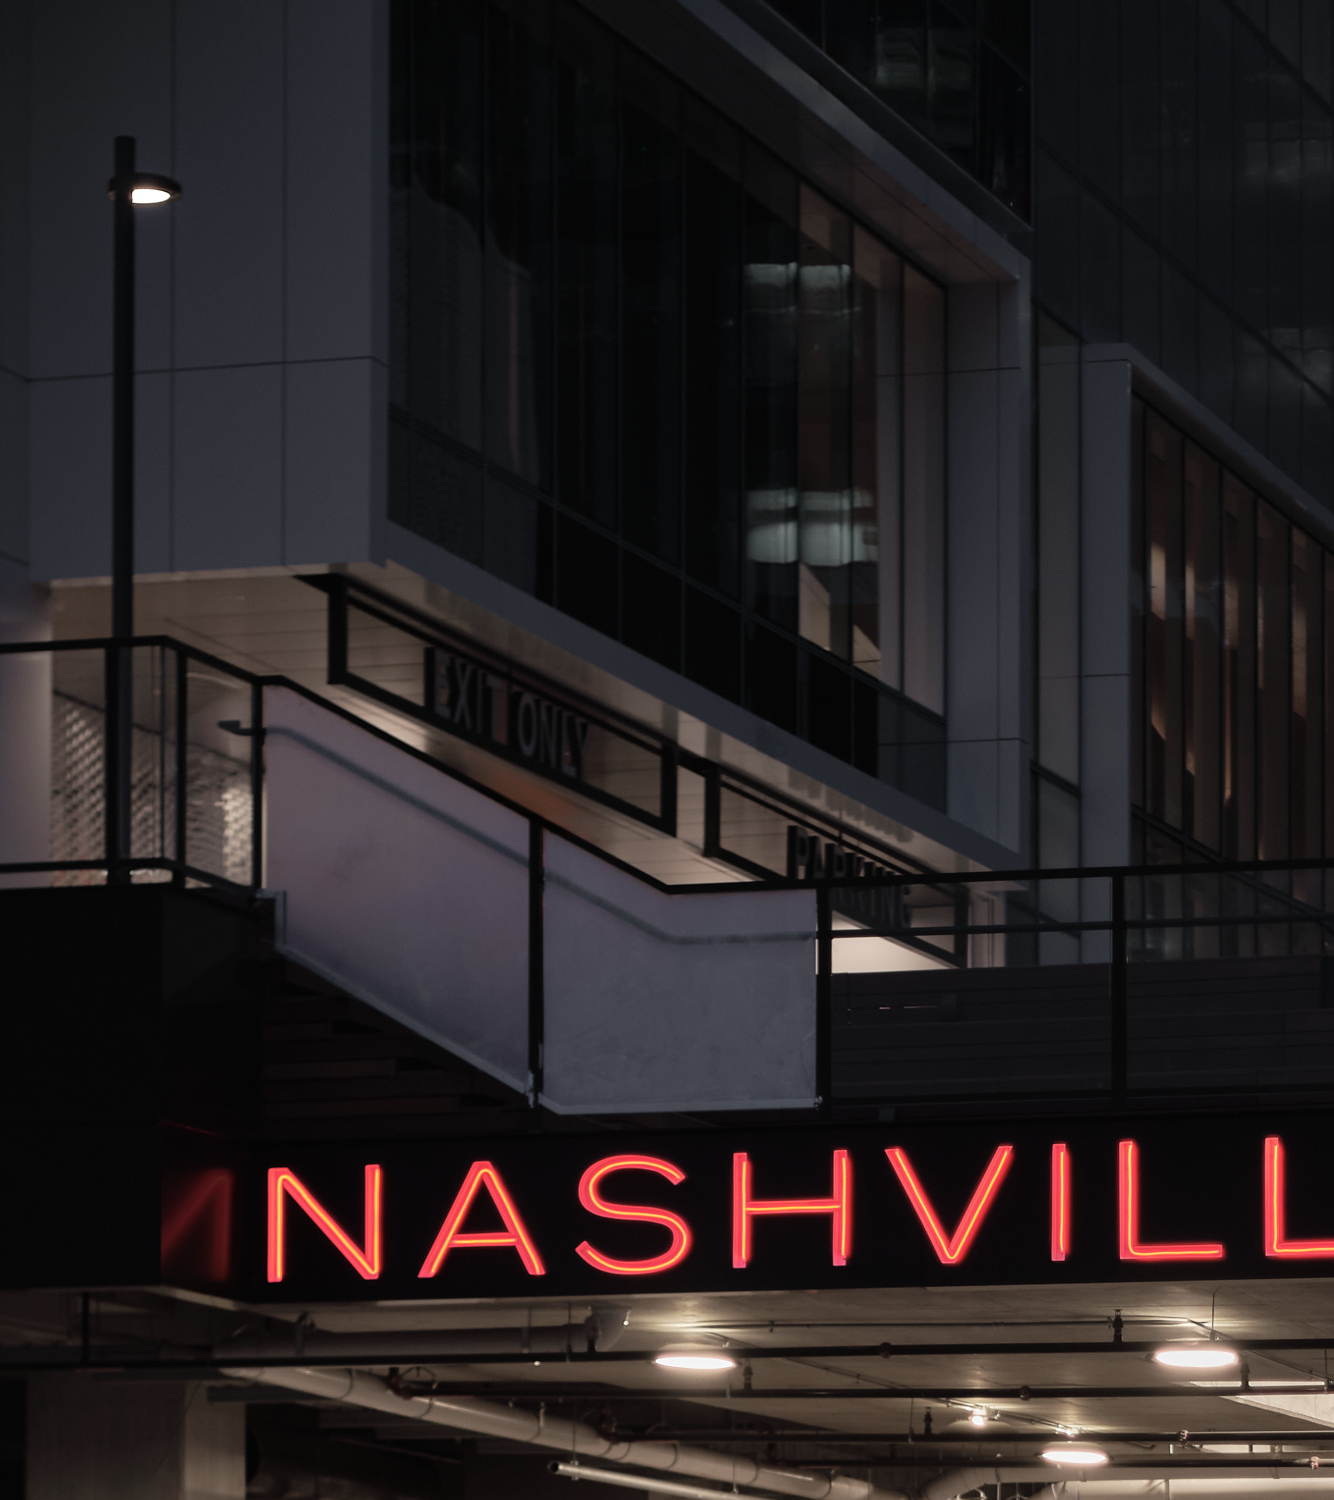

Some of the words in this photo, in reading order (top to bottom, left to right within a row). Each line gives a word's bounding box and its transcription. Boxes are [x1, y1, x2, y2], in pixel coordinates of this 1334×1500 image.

[426, 648, 505, 740] EXIT
[512, 690, 589, 783] ONLY
[788, 825, 912, 929] PARKING
